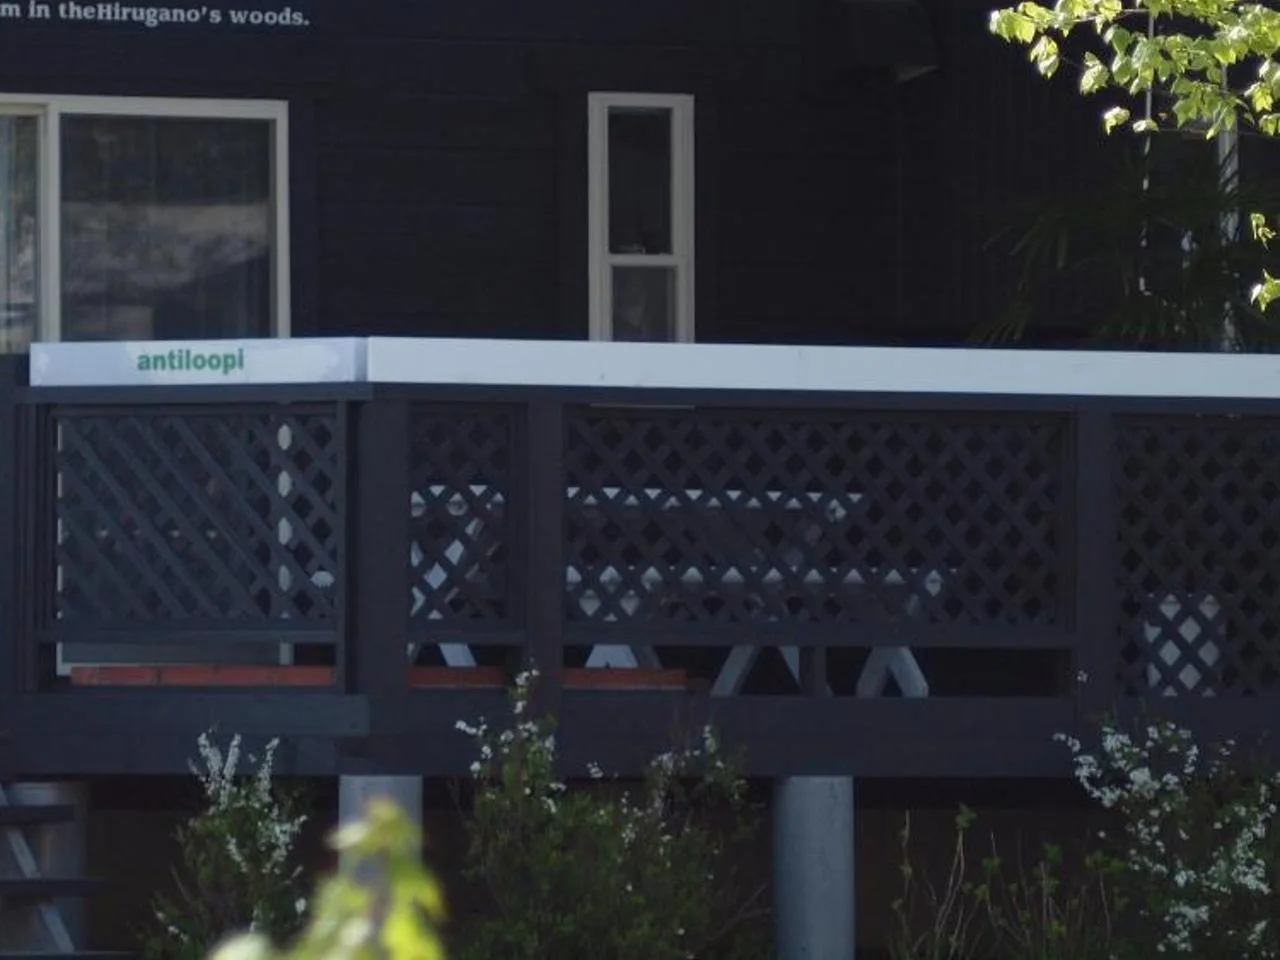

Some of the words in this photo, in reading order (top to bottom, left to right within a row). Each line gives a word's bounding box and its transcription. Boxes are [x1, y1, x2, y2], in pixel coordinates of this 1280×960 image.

[29, 0, 50, 18] in
[229, 7, 309, 25] woods.
[138, 349, 245, 374] antiloopi
